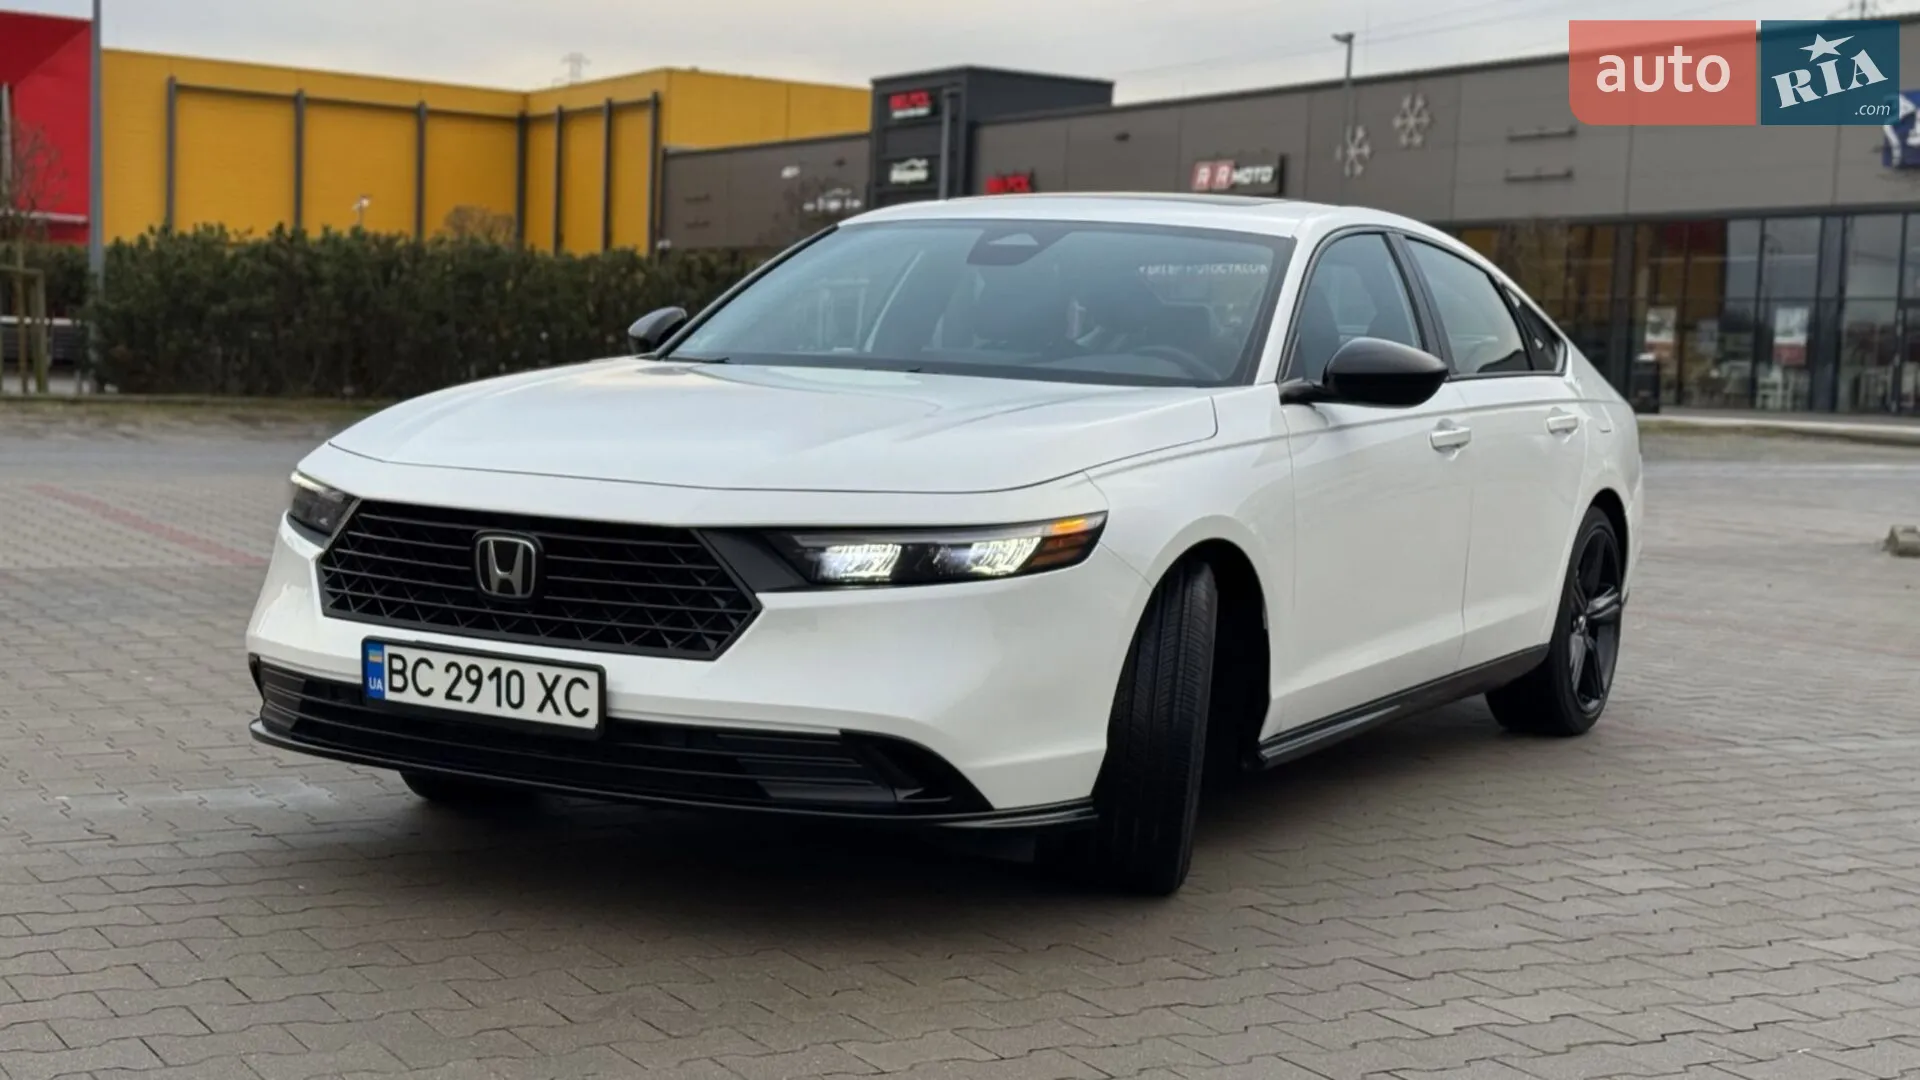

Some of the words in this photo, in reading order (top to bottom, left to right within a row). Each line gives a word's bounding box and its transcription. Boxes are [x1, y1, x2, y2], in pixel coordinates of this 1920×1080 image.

[368, 677, 384, 692] UA
[387, 652, 435, 698] BC
[444, 661, 526, 710] 2910
[536, 671, 590, 719] XC
